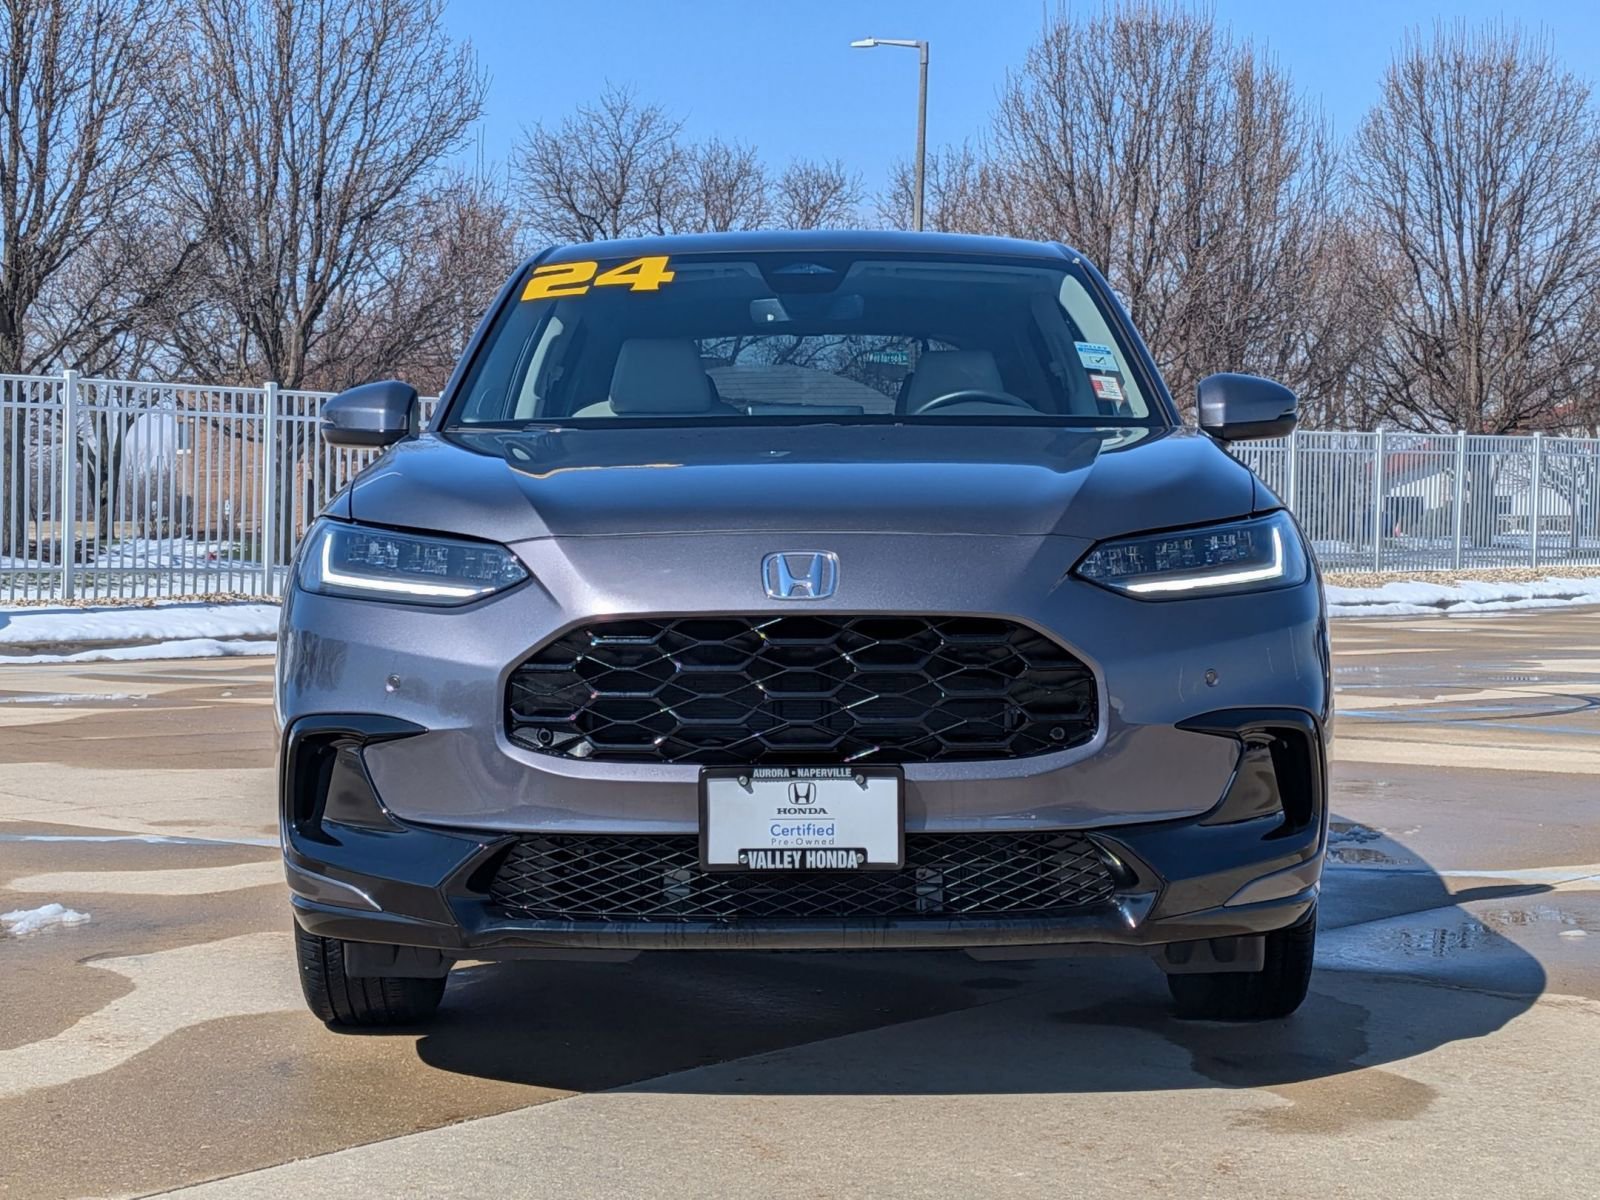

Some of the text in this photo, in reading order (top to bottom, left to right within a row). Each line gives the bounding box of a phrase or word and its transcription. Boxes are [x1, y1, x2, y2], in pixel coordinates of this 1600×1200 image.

[521, 256, 675, 301] 24
[753, 768, 852, 778] AURORA NAPERVILLE
[770, 823, 835, 836] Certified
[771, 838, 835, 846] Pre-Owned
[748, 850, 858, 869] VALLEY HONDA
